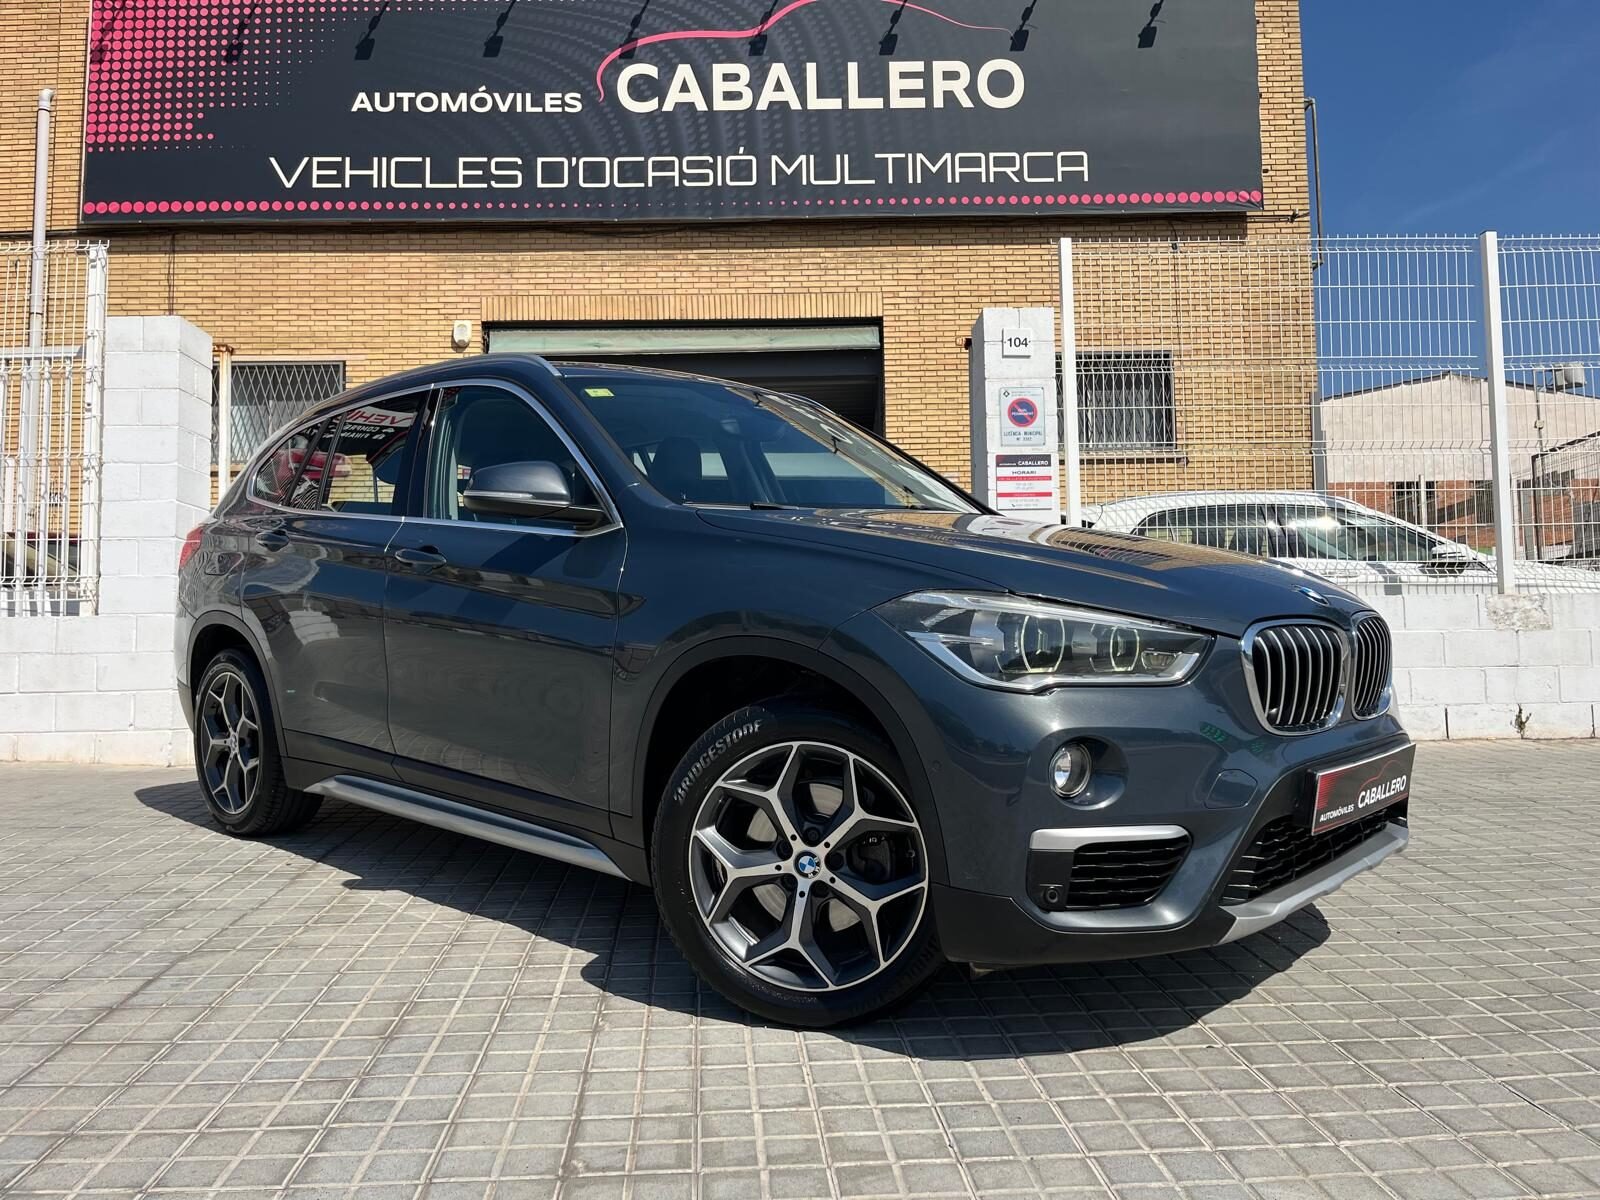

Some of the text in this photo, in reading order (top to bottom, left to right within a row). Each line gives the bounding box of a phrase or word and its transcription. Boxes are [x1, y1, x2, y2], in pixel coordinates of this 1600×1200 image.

[351, 58, 1026, 114] AUTOMÓVILES CABALLERO
[269, 147, 1090, 190] VEHICLES D'OCASIÓ MULTIMARCA
[1007, 337, 1029, 348] 104
[1319, 774, 1408, 823] AUTOMÓVILES CABALLERO
